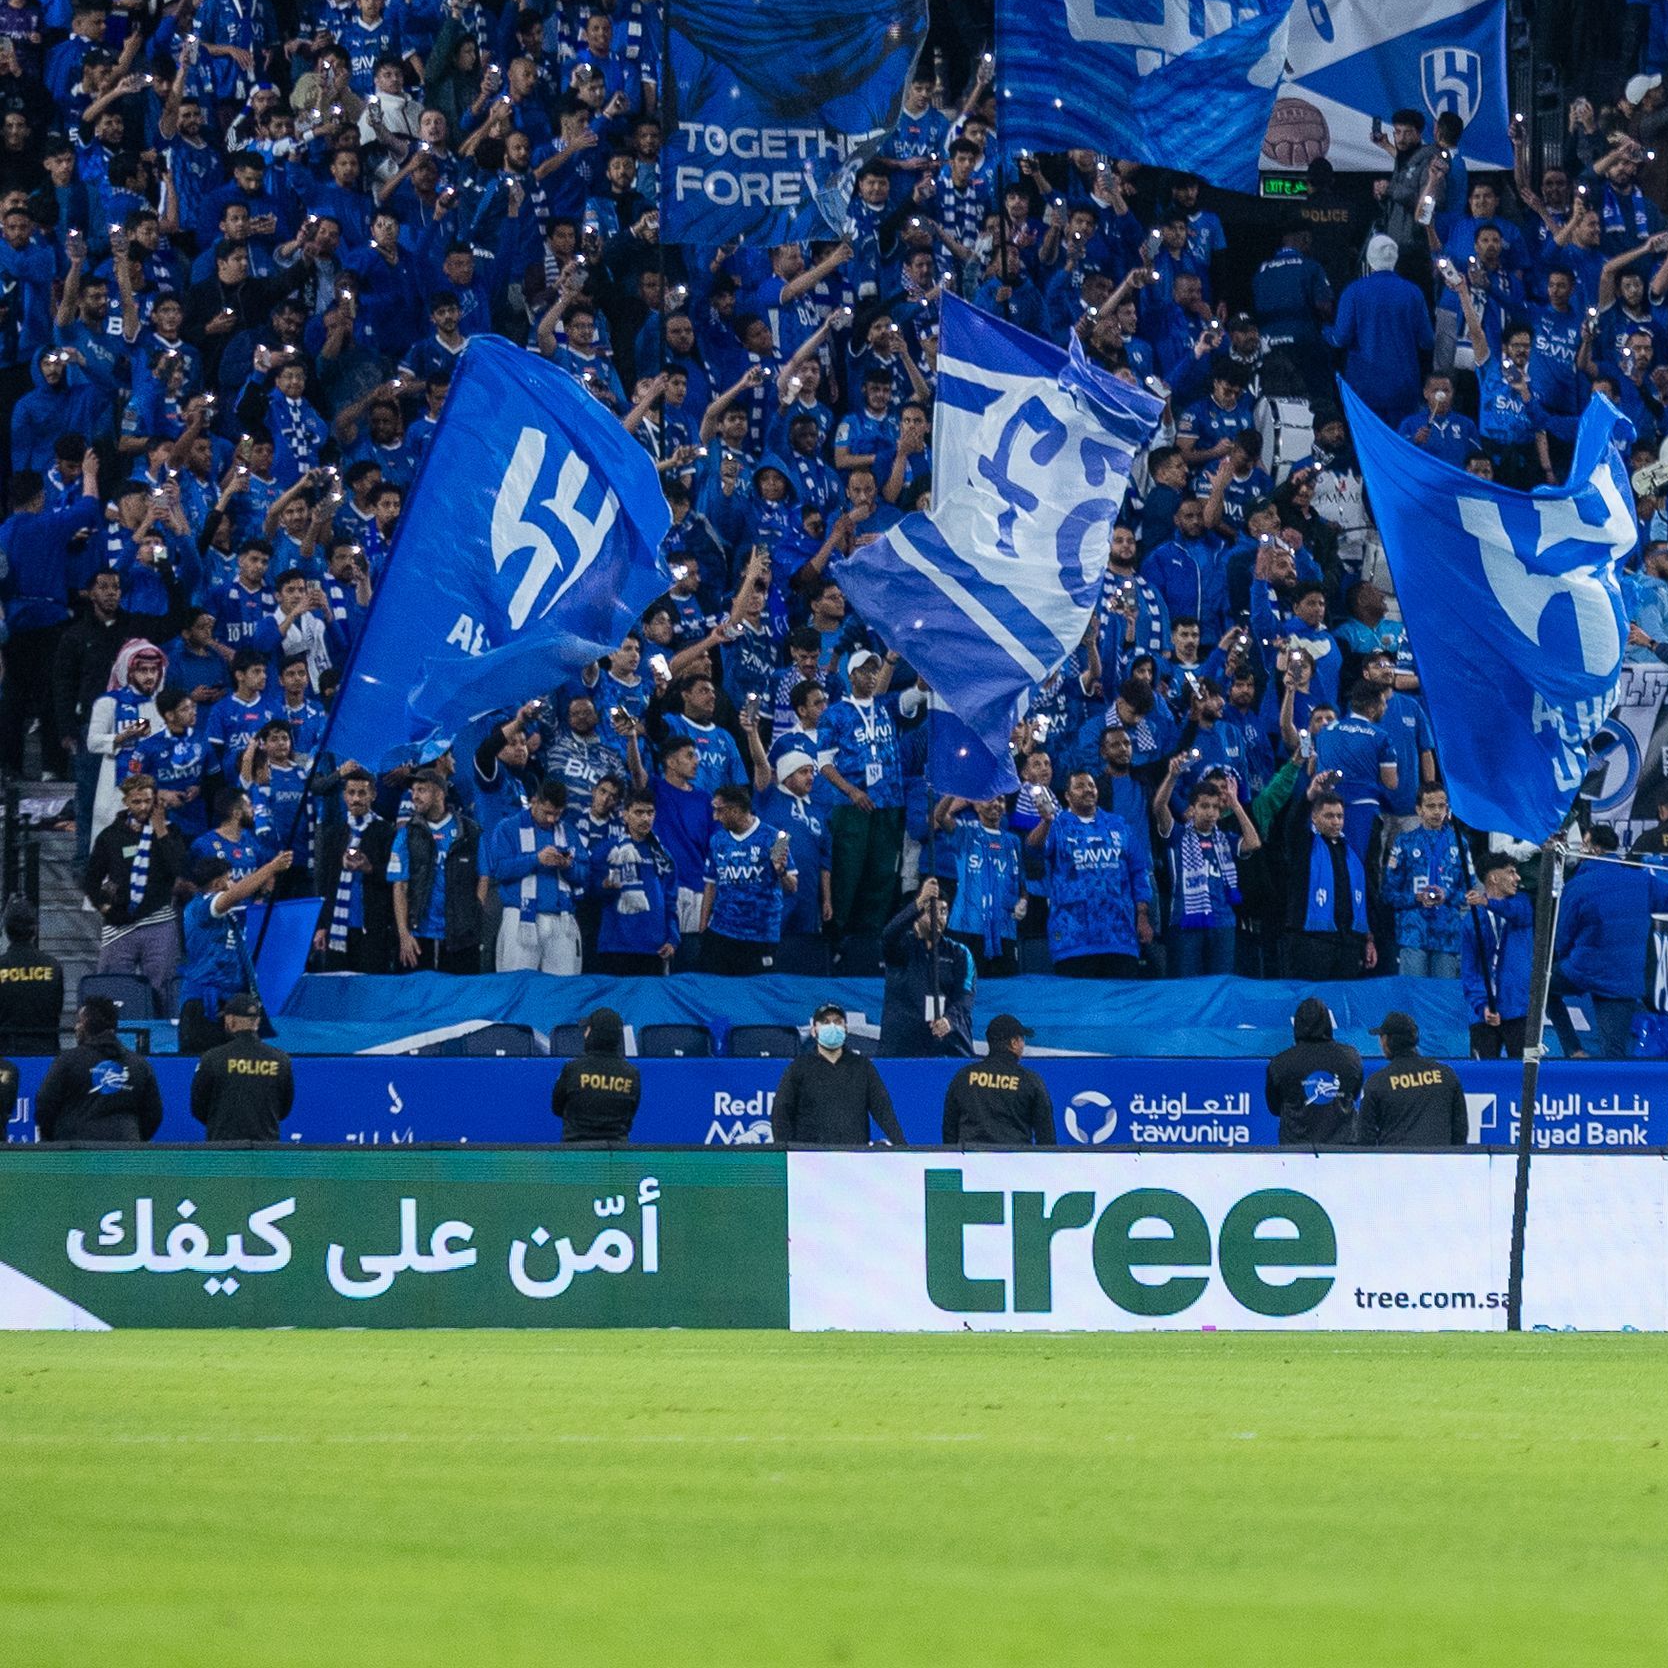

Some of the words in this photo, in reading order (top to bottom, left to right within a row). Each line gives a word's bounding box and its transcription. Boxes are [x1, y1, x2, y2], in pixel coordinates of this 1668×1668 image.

[678, 121, 886, 163] TOGETHE
[676, 166, 819, 207] FORE
[1264, 180, 1284, 194] EXIT
[1301, 208, 1349, 223] POLICE
[1536, 335, 1577, 356] SAVVY
[1073, 848, 1122, 863] SAVVY
[717, 866, 764, 881] SAVVY
[0, 967, 54, 983] POLICE
[227, 1059, 279, 1076] POLICE
[580, 1073, 633, 1094] POLICE
[969, 1071, 1019, 1091] POLICE
[1390, 1069, 1442, 1090] POLICE
[1130, 1092, 1250, 1120] التعاونية
[1587, 1093, 1650, 1120] بنك
[1131, 1123, 1250, 1148] tawuniya
[1587, 1122, 1648, 1146] Bank
[66, 1196, 296, 1297] كيفك
[325, 1198, 478, 1299] على
[925, 1169, 1337, 1318] tree
[1355, 1288, 1514, 1310] tree.com.sa
